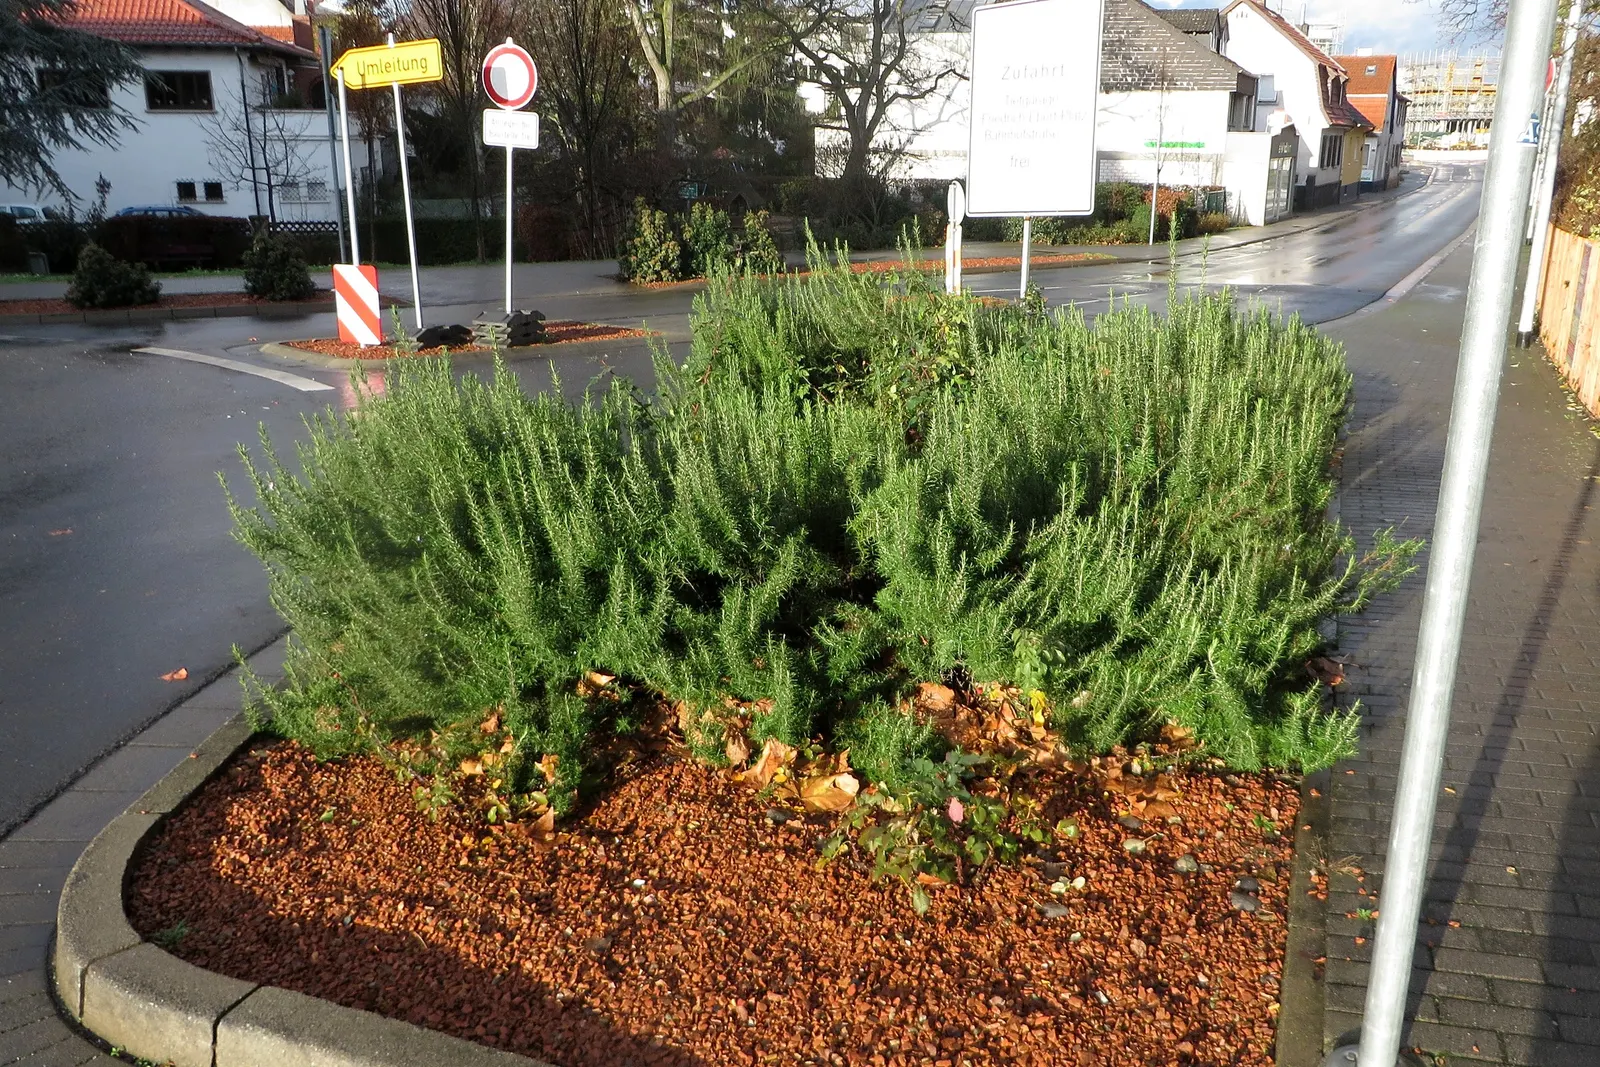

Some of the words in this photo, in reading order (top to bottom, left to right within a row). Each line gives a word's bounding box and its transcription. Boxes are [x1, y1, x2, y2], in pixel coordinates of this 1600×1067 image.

[356, 57, 428, 77] Umleitung
[1001, 63, 1064, 81] Zufahrt
[1010, 153, 1031, 168] frei
